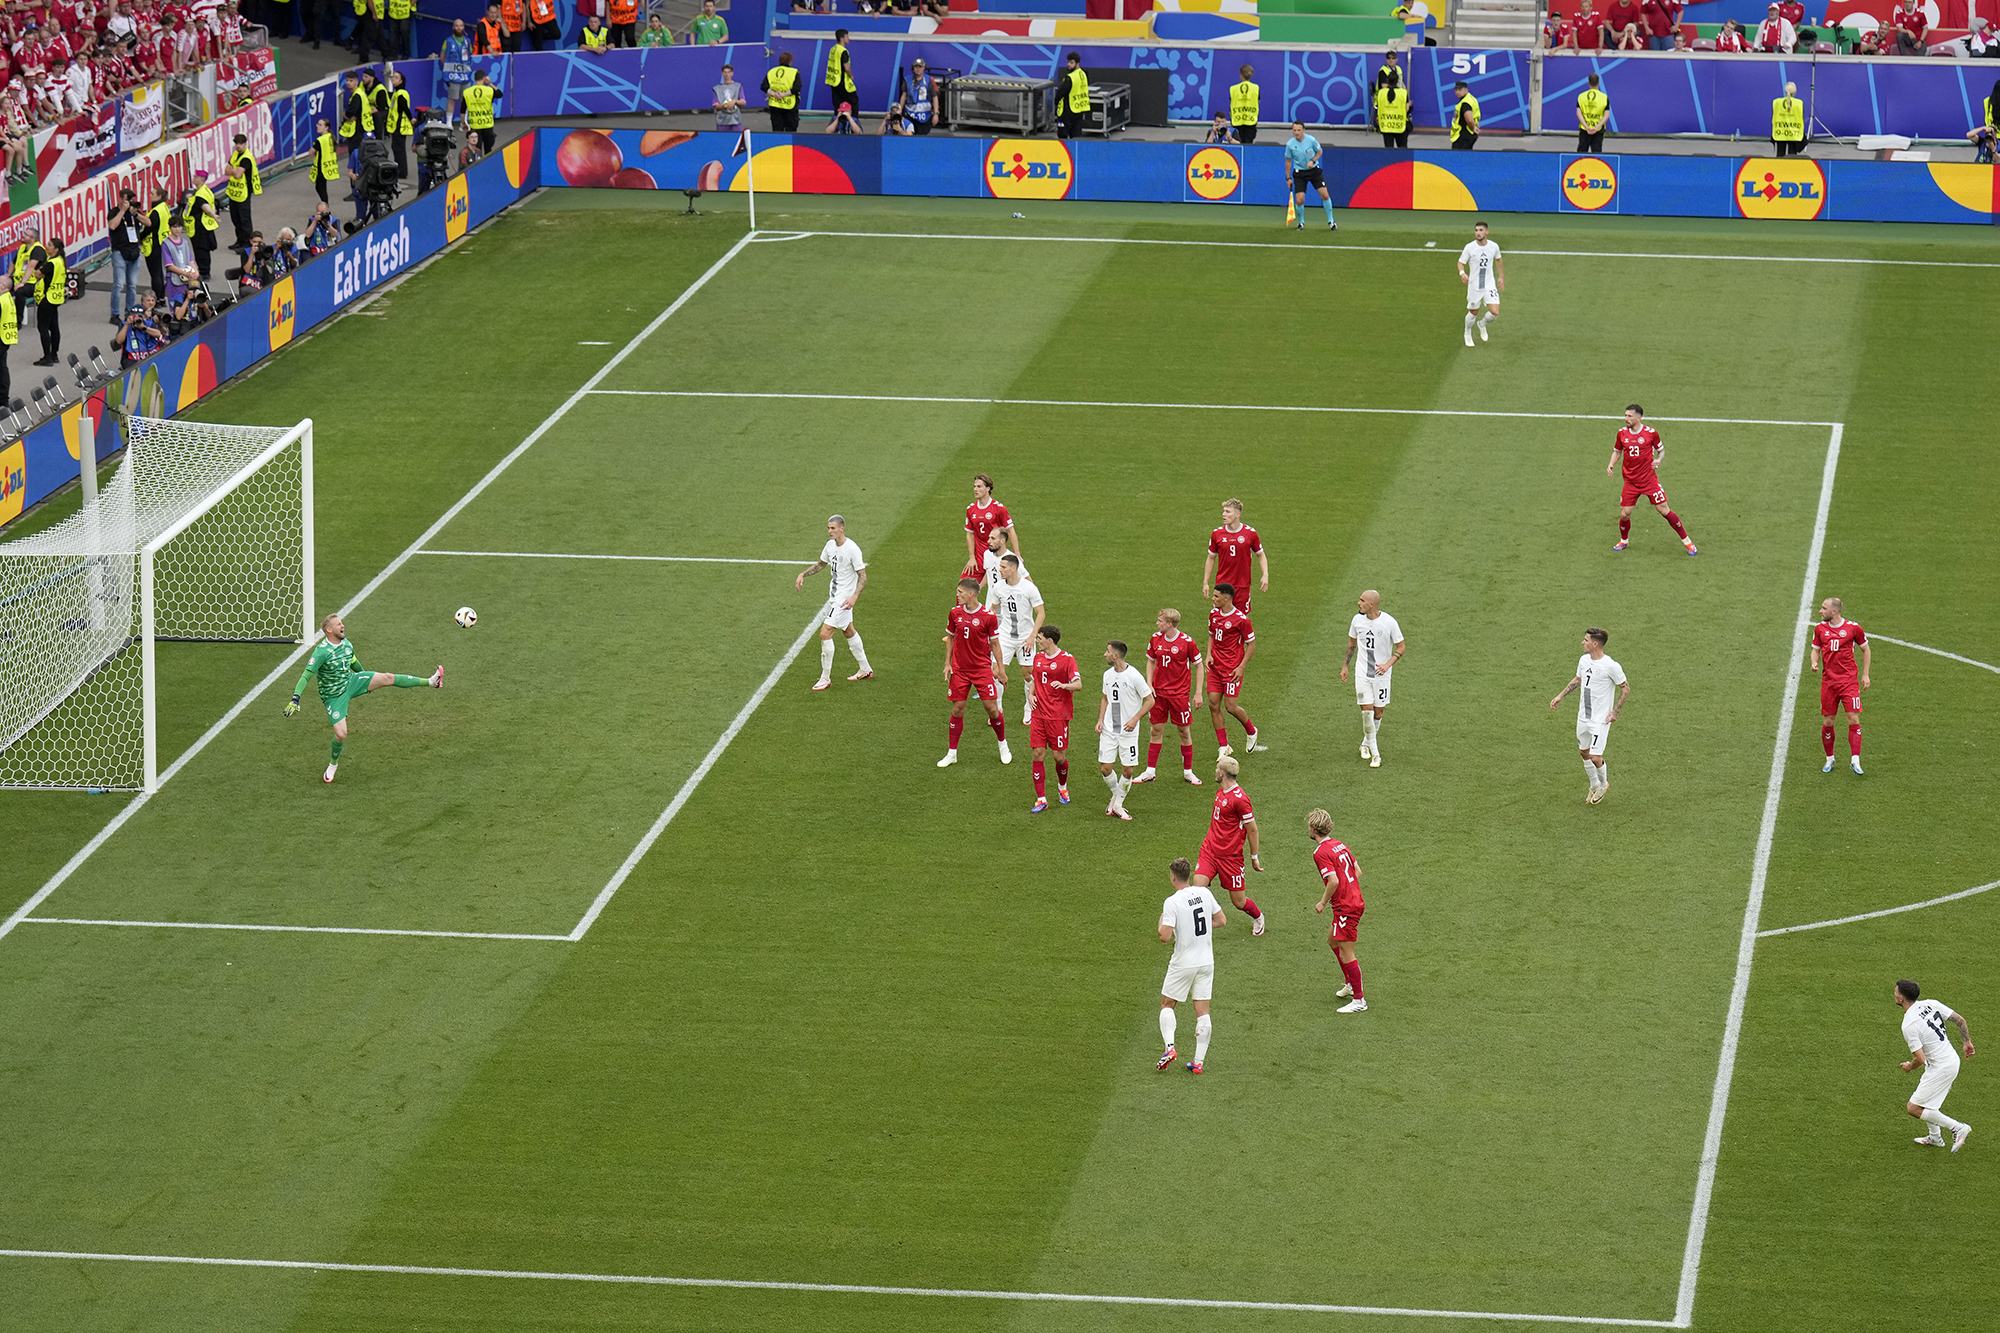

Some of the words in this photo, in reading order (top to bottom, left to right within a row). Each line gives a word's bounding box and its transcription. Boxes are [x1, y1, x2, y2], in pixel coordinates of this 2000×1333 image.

[1451, 53, 1487, 75] 51
[308, 91, 325, 116] 37
[41, 180, 107, 250] URBACH
[334, 250, 361, 306] Eat
[365, 214, 410, 285] fresh
[1479, 258, 1489, 267] 22
[1628, 446, 1640, 457] 23
[1652, 490, 1665, 503] 23
[979, 522, 986, 534] 2
[1229, 545, 1236, 556] 9
[992, 573, 998, 584] 5
[1007, 601, 1017, 613] 19
[963, 626, 970, 639] 3
[1214, 628, 1224, 641] 18
[1365, 637, 1376, 649] 21
[1829, 639, 1840, 652] 10
[1041, 672, 1048, 684] 6
[987, 683, 995, 697] 3
[1112, 689, 1119, 701] 9
[1226, 682, 1236, 696] 18
[1378, 688, 1388, 700] 21
[1851, 697, 1861, 710] 10
[1057, 735, 1064, 748] 6
[1129, 745, 1137, 757] 9
[1231, 875, 1243, 889] 19
[1192, 907, 1208, 937] 6
